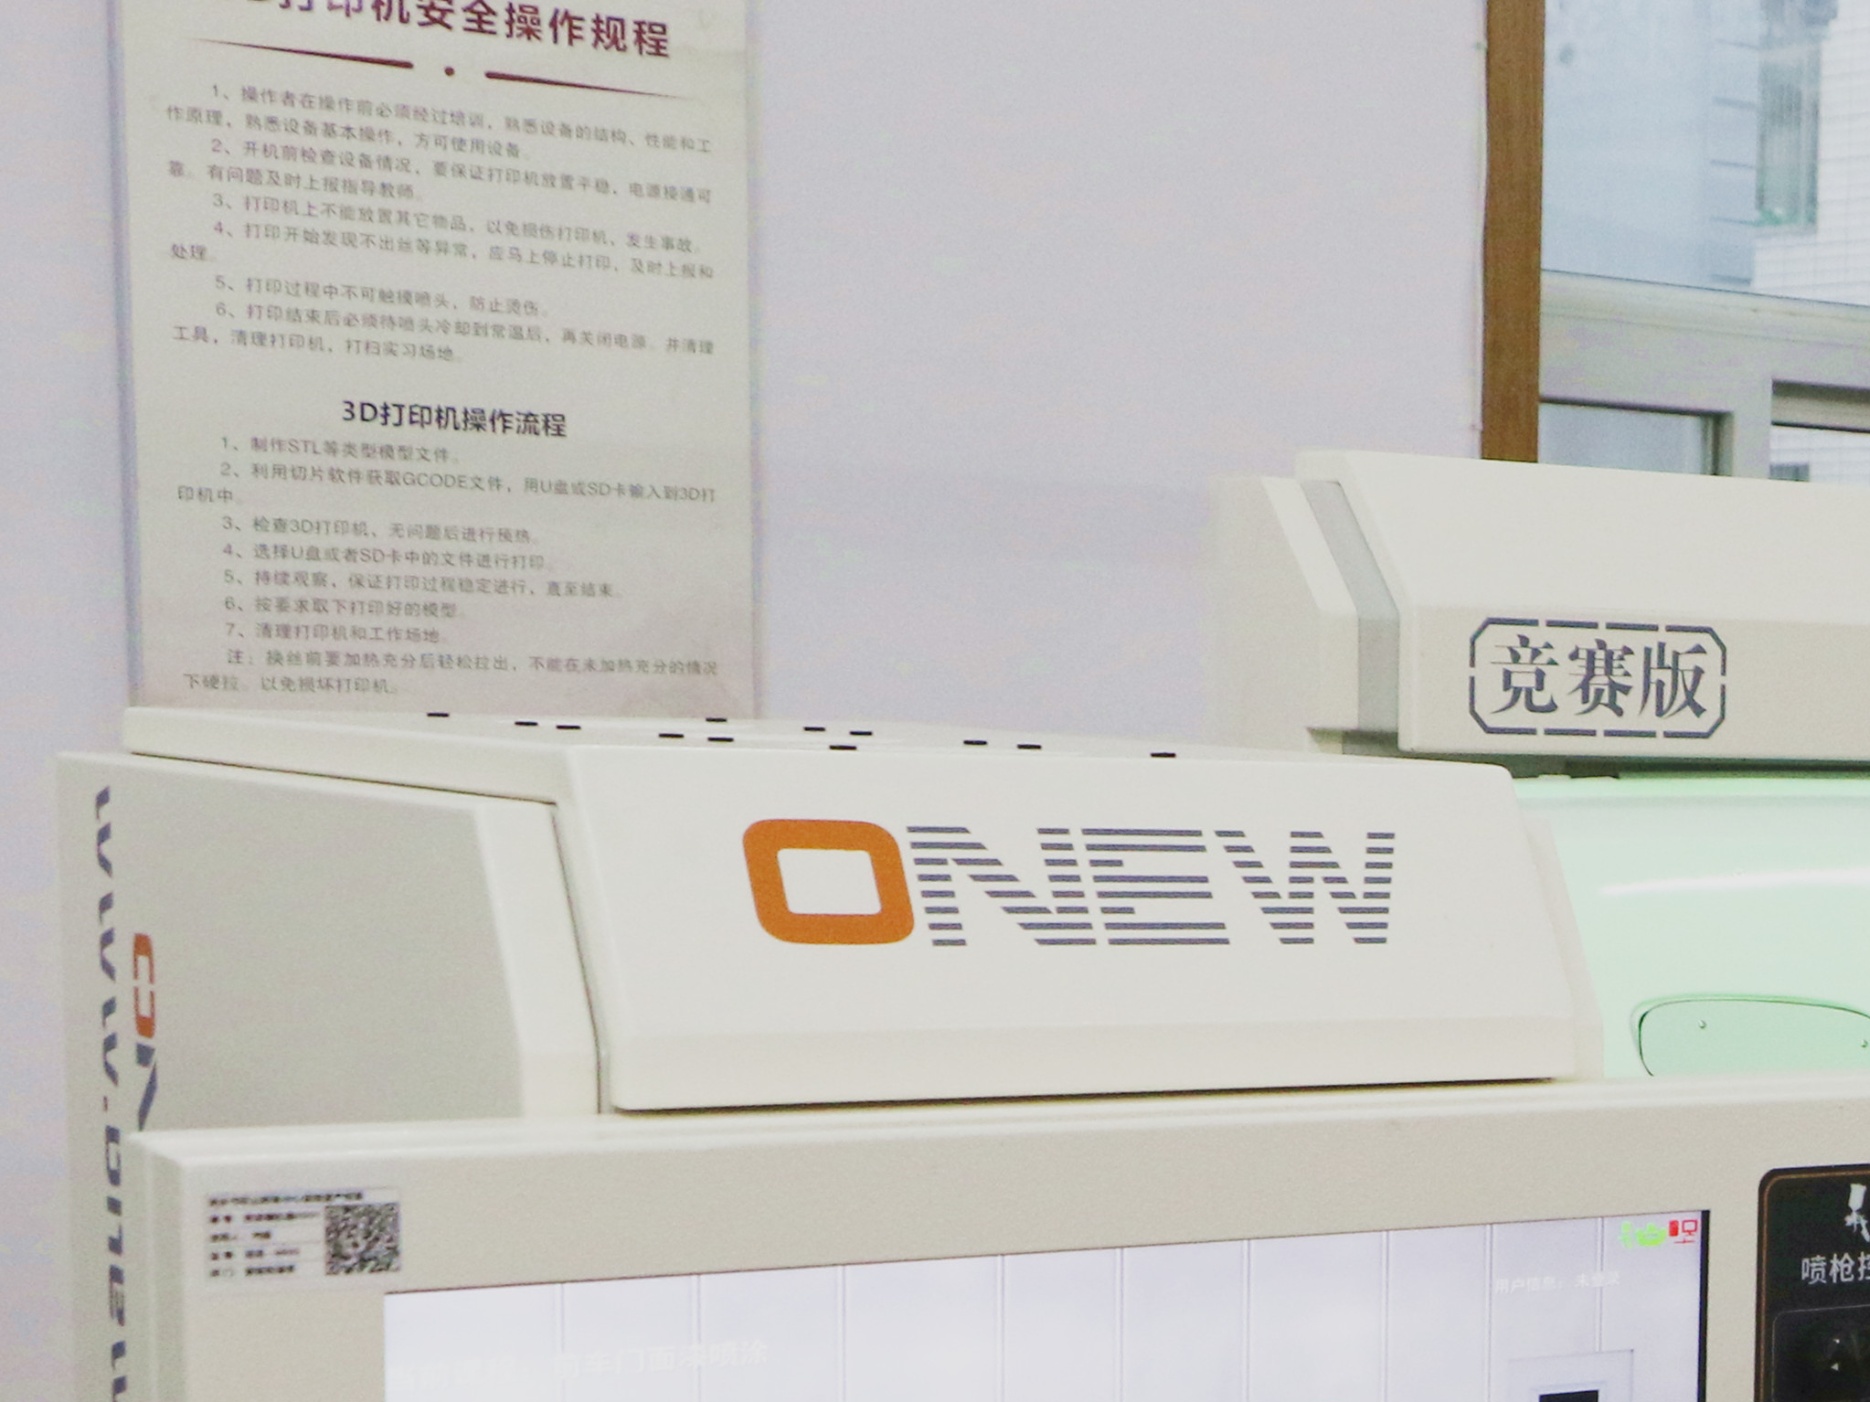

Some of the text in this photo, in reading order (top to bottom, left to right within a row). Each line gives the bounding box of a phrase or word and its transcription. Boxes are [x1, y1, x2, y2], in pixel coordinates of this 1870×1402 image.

[279, 0, 670, 59] 机安全操作规程
[341, 399, 568, 438] 3D打印机操作流程
[1490, 633, 1708, 718] 竞赛版
[742, 818, 1396, 946] ONEW
